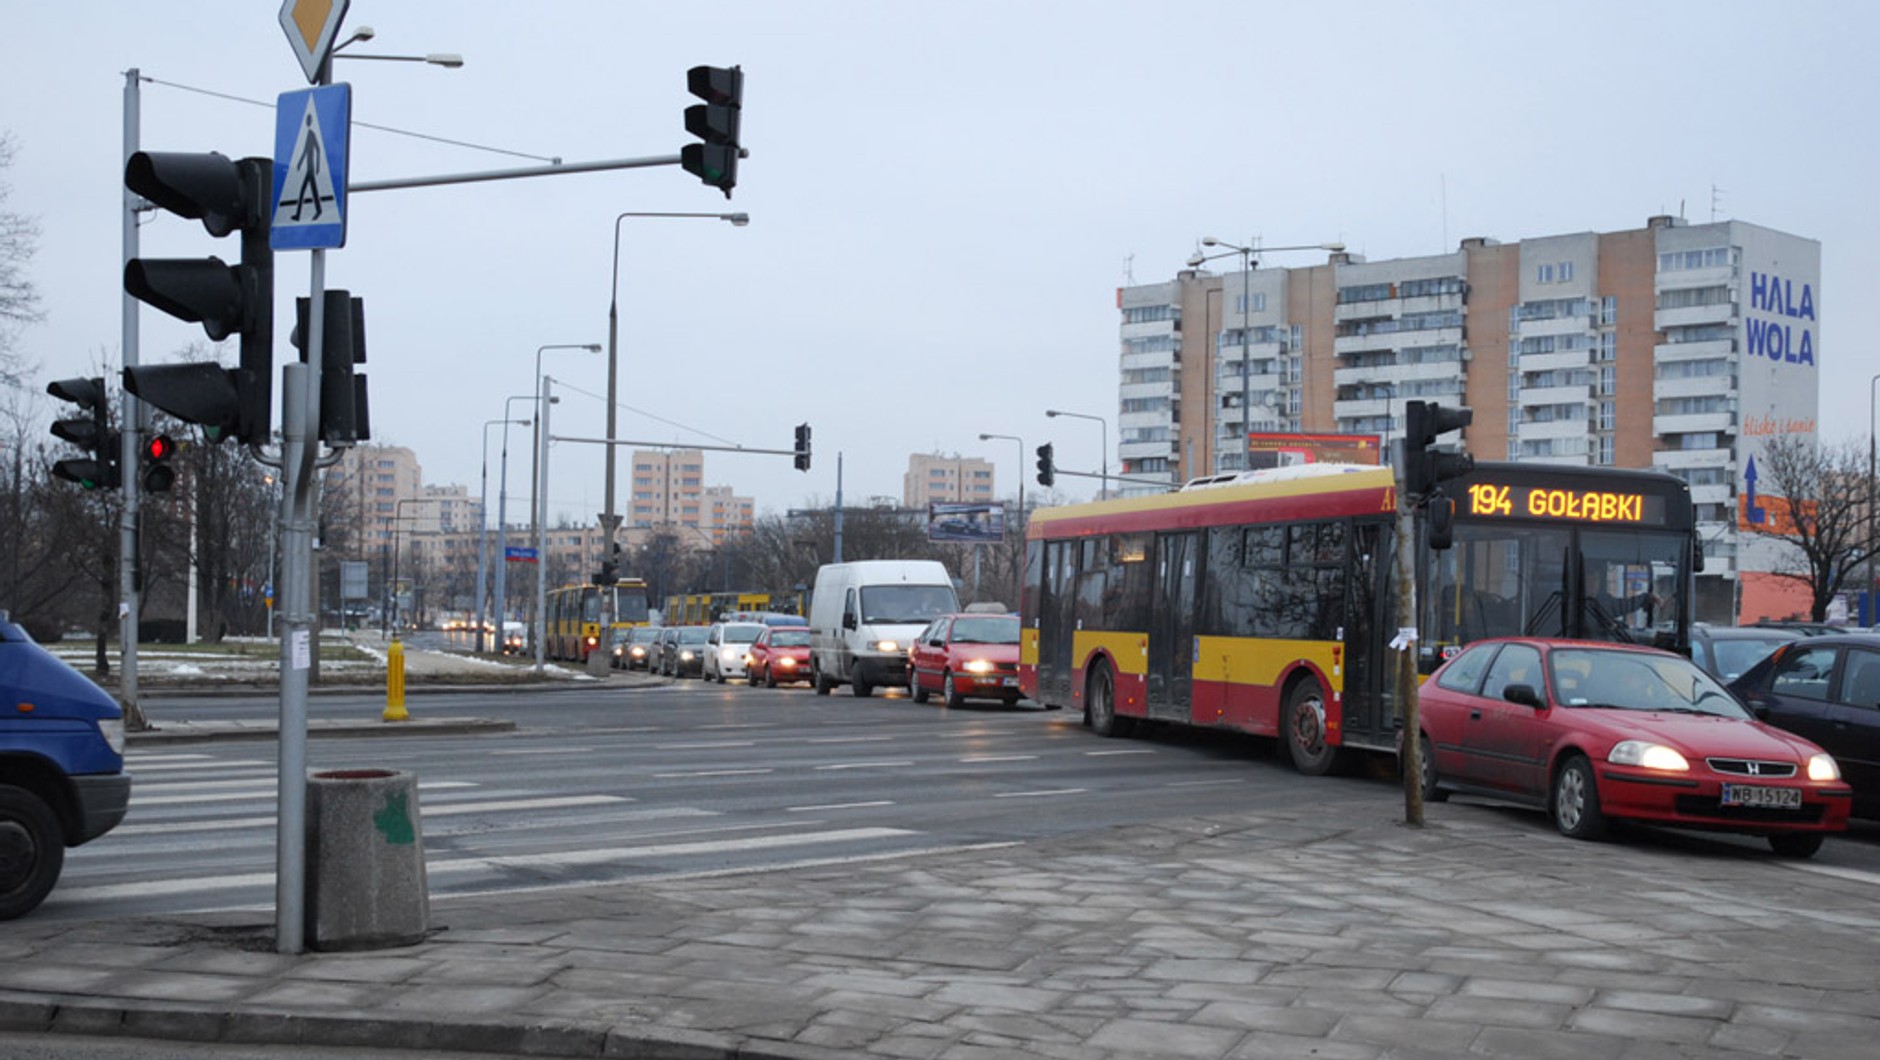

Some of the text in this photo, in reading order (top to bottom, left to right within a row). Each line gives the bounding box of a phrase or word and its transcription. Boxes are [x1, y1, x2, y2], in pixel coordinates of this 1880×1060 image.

[1750, 271, 1816, 322] HALA
[1745, 316, 1815, 367] WOLA
[1468, 484, 1644, 522] 194 GOŁĄBKI
[1758, 788, 1799, 805] 15124
